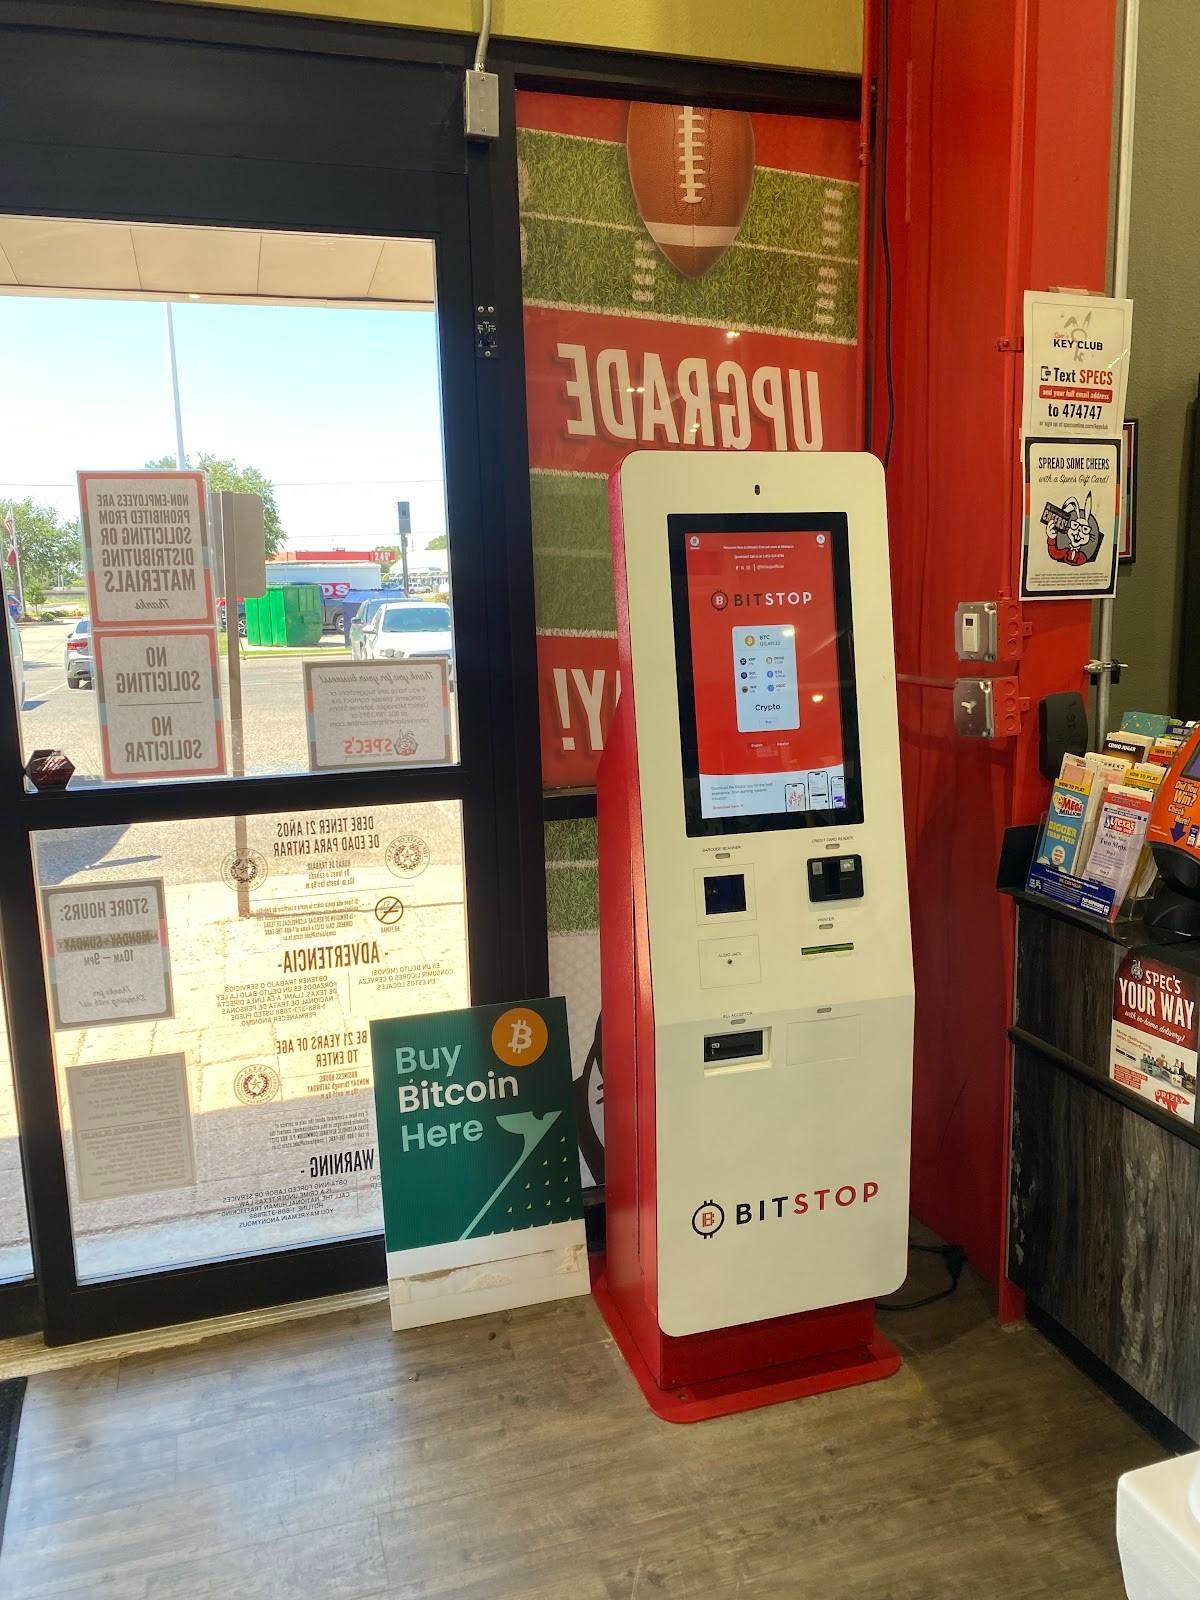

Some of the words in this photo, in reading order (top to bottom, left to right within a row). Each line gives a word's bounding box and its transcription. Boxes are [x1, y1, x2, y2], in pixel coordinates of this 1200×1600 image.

[1054, 339, 1074, 348] KEY
[1077, 341, 1103, 350] CLUB
[1054, 368, 1076, 383] Text
[1080, 370, 1113, 385] SPECS
[1048, 403, 1058, 416] to
[1063, 404, 1102, 419] 474747
[1039, 457, 1065, 469] SPREAD
[1067, 458, 1084, 470] SOME
[1086, 458, 1109, 470] CHEERS
[1039, 474, 1052, 482] with
[1079, 475, 1089, 486] Gift
[1091, 475, 1109, 483] Card!
[734, 592, 812, 606] BITSTOP
[1186, 783, 1199, 792] You
[1061, 797, 1082, 812] MEGA
[1174, 790, 1198, 806] Win?
[1168, 805, 1184, 813] Check
[1176, 815, 1190, 825] Here!
[1048, 821, 1077, 836] BIGGER
[1146, 970, 1181, 994] SPEC'S
[1119, 977, 1155, 1017] YOUR
[1161, 992, 1194, 1030] WAY
[1125, 1010, 1136, 1020] with
[1160, 1025, 1185, 1043] delivery!
[395, 1045, 462, 1077] Buy
[398, 1070, 519, 1114] Bitcoin
[1156, 1091, 1185, 1102] DRIZLY
[401, 1119, 483, 1152] Here
[736, 1181, 879, 1225] BITSTOP
